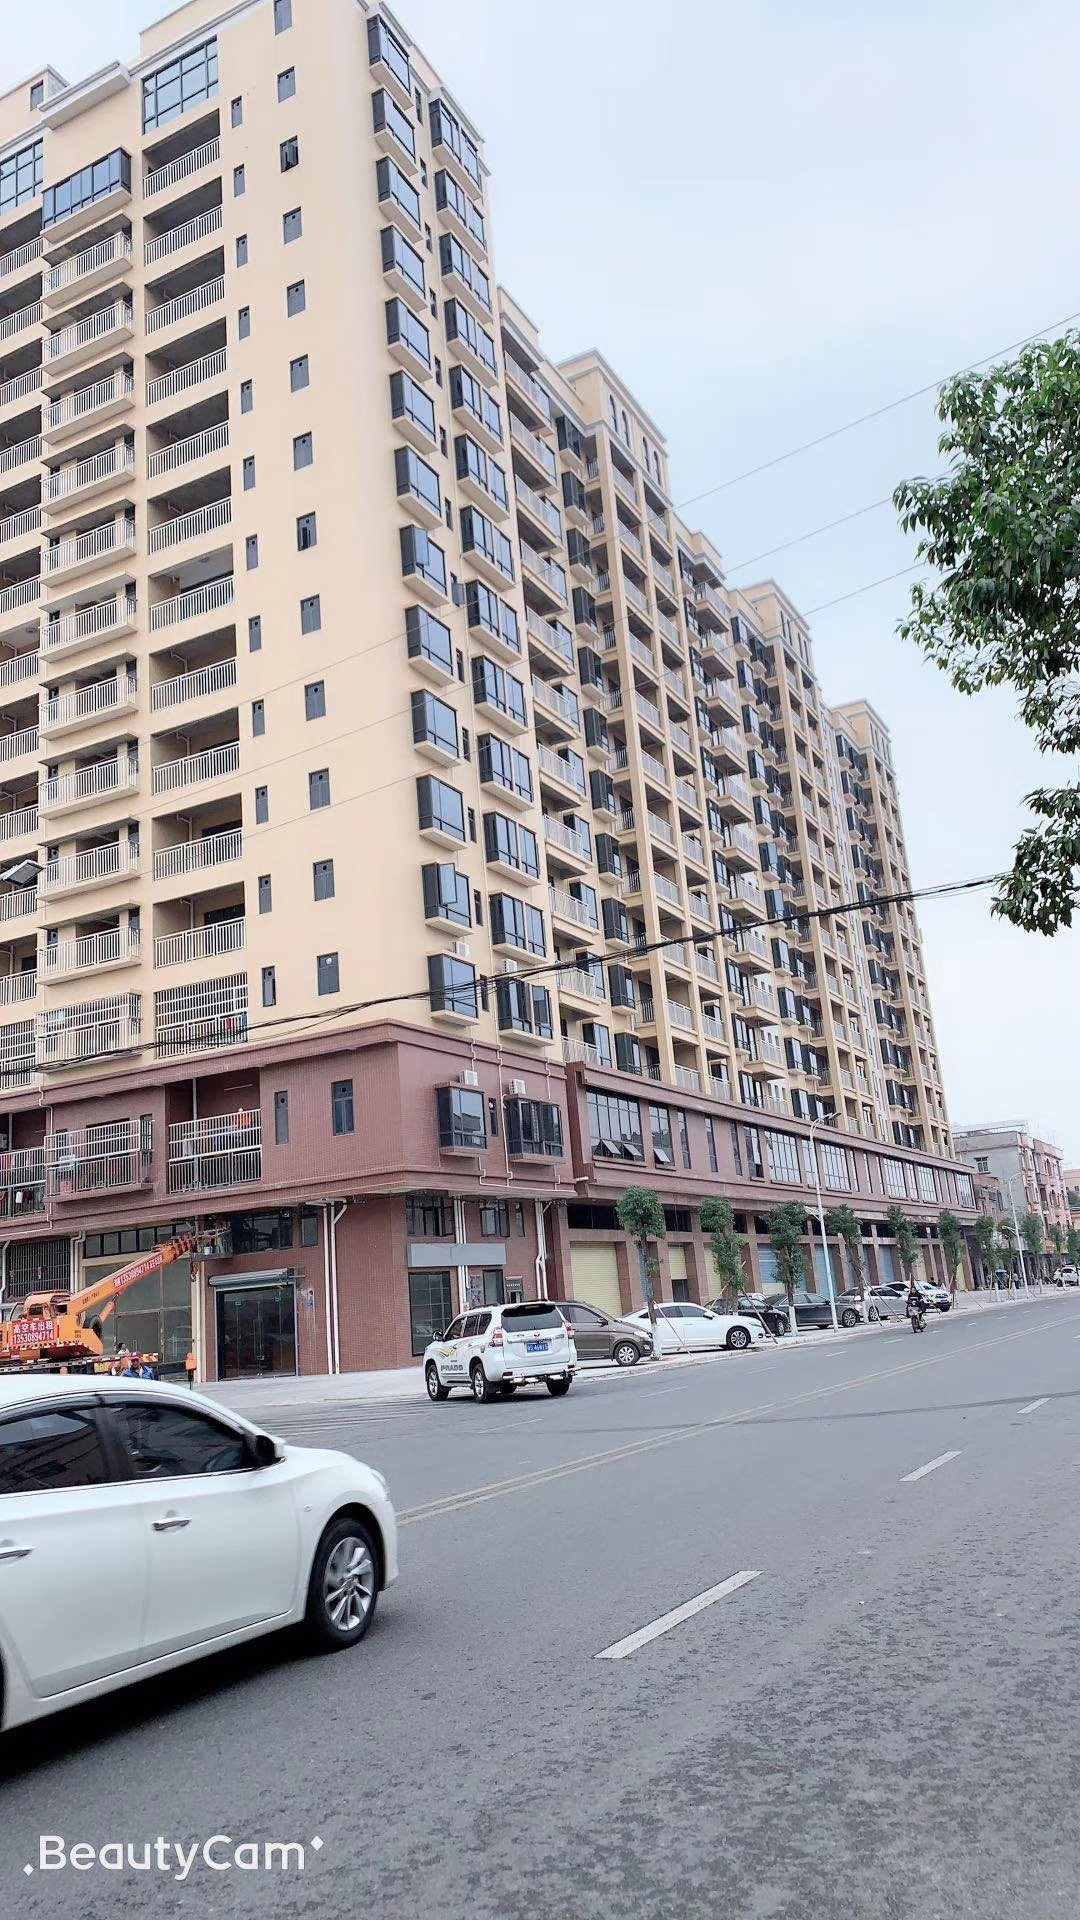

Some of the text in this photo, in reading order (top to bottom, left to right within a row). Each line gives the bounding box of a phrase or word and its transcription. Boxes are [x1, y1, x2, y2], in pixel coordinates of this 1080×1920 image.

[14, 1321, 53, 1333] 高空车出租
[14, 1331, 54, 1344] 13530894714
